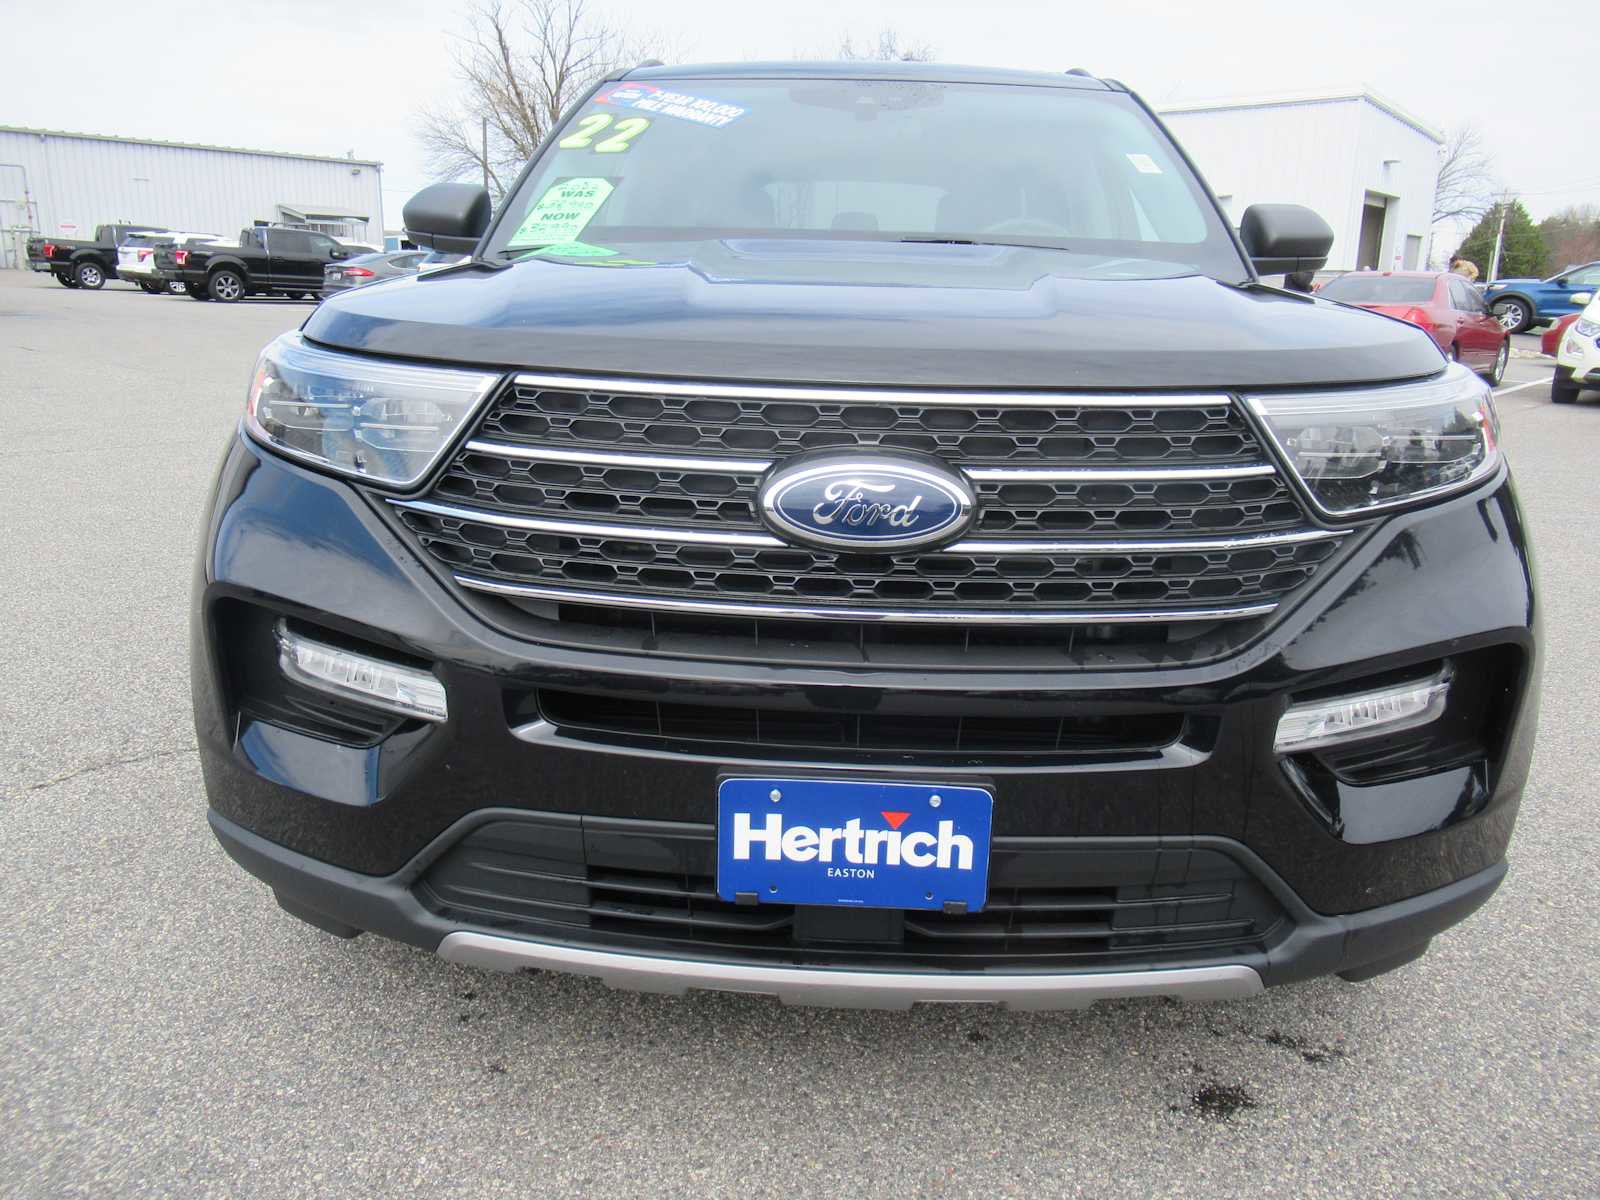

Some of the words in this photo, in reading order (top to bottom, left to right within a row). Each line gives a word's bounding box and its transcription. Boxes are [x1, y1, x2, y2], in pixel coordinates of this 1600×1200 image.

[559, 113, 651, 153] 22
[561, 190, 596, 198] WAS
[540, 212, 581, 221] NOW
[812, 478, 923, 527] Ford
[733, 811, 974, 871] Hertrich
[827, 867, 875, 880] EASTON
